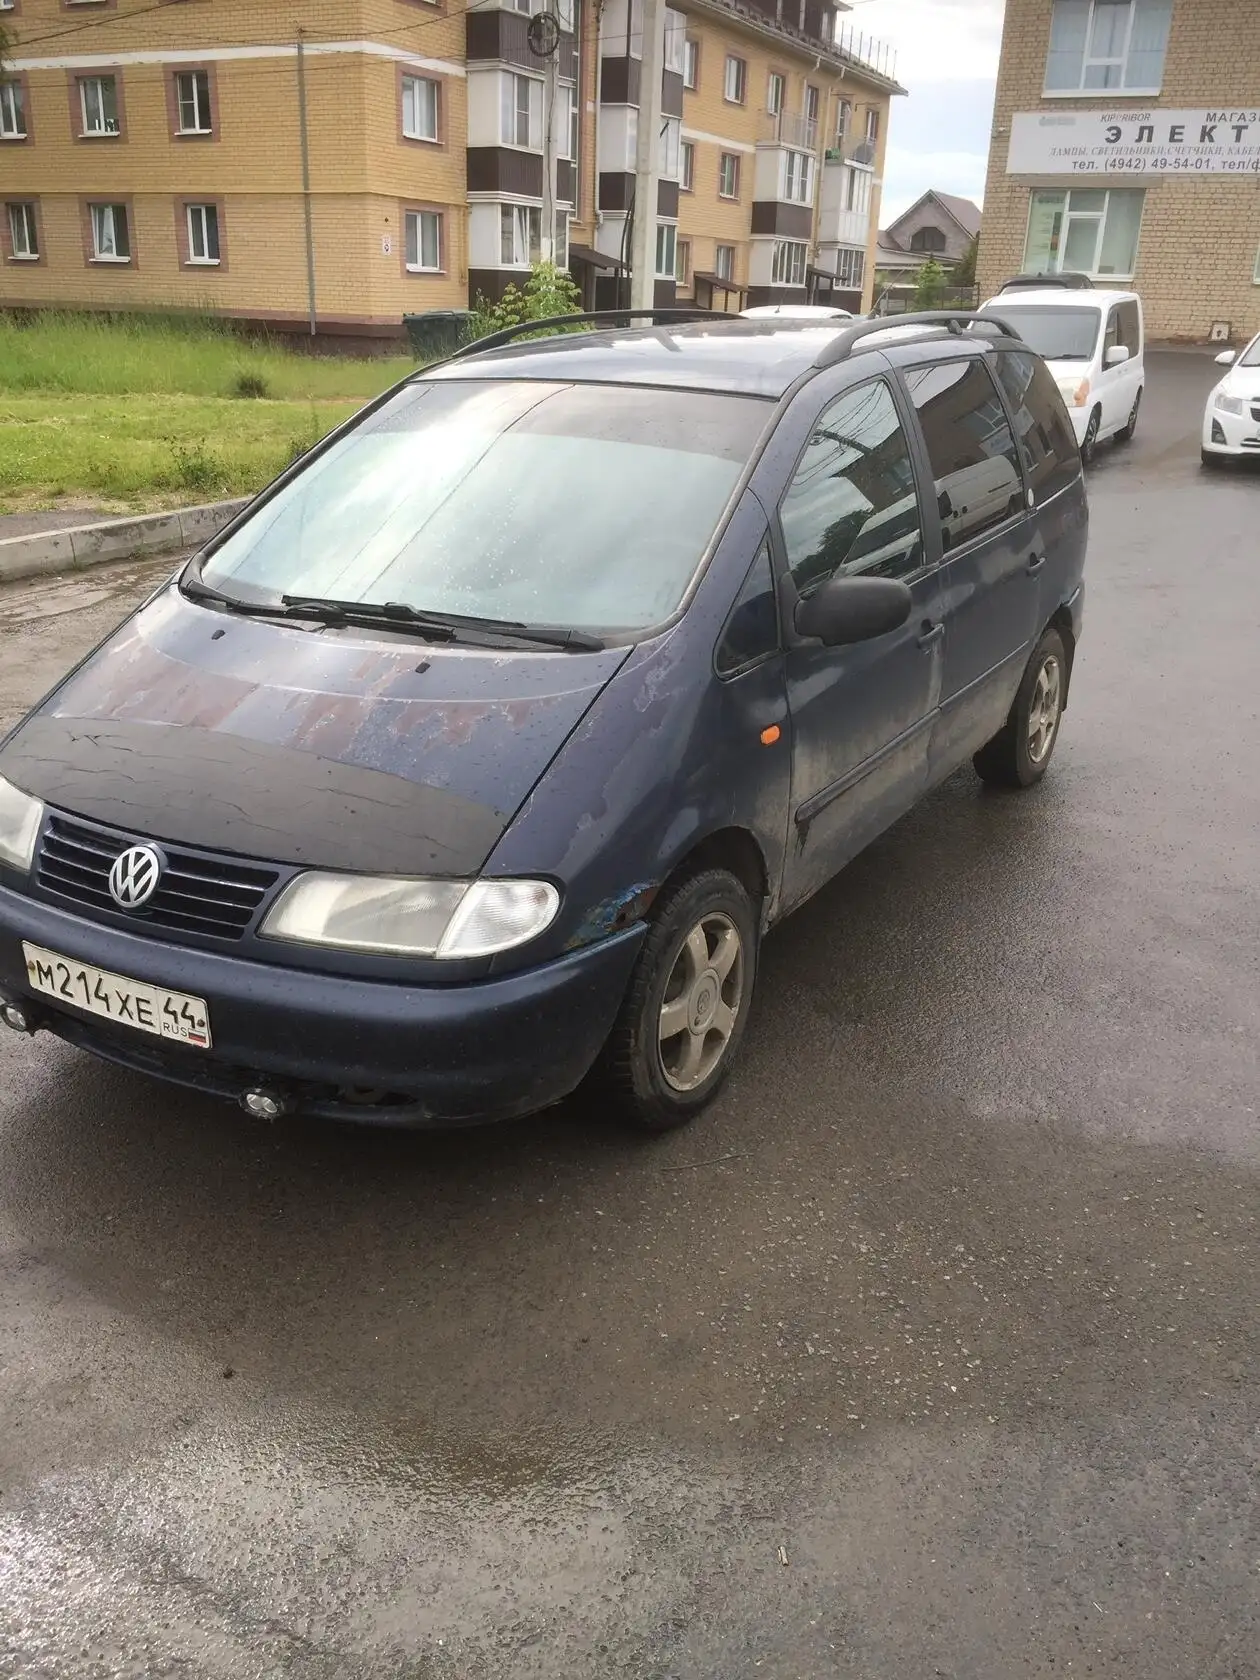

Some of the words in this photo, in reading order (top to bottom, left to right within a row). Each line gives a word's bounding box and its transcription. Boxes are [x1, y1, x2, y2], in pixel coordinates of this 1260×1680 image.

[1206, 112, 1260, 122] МАГАЗ
[1071, 160, 1099, 170] тел.
[1105, 157, 1146, 171] (4942)
[163, 996, 196, 1029] 44
[163, 1022, 188, 1038] RUS
